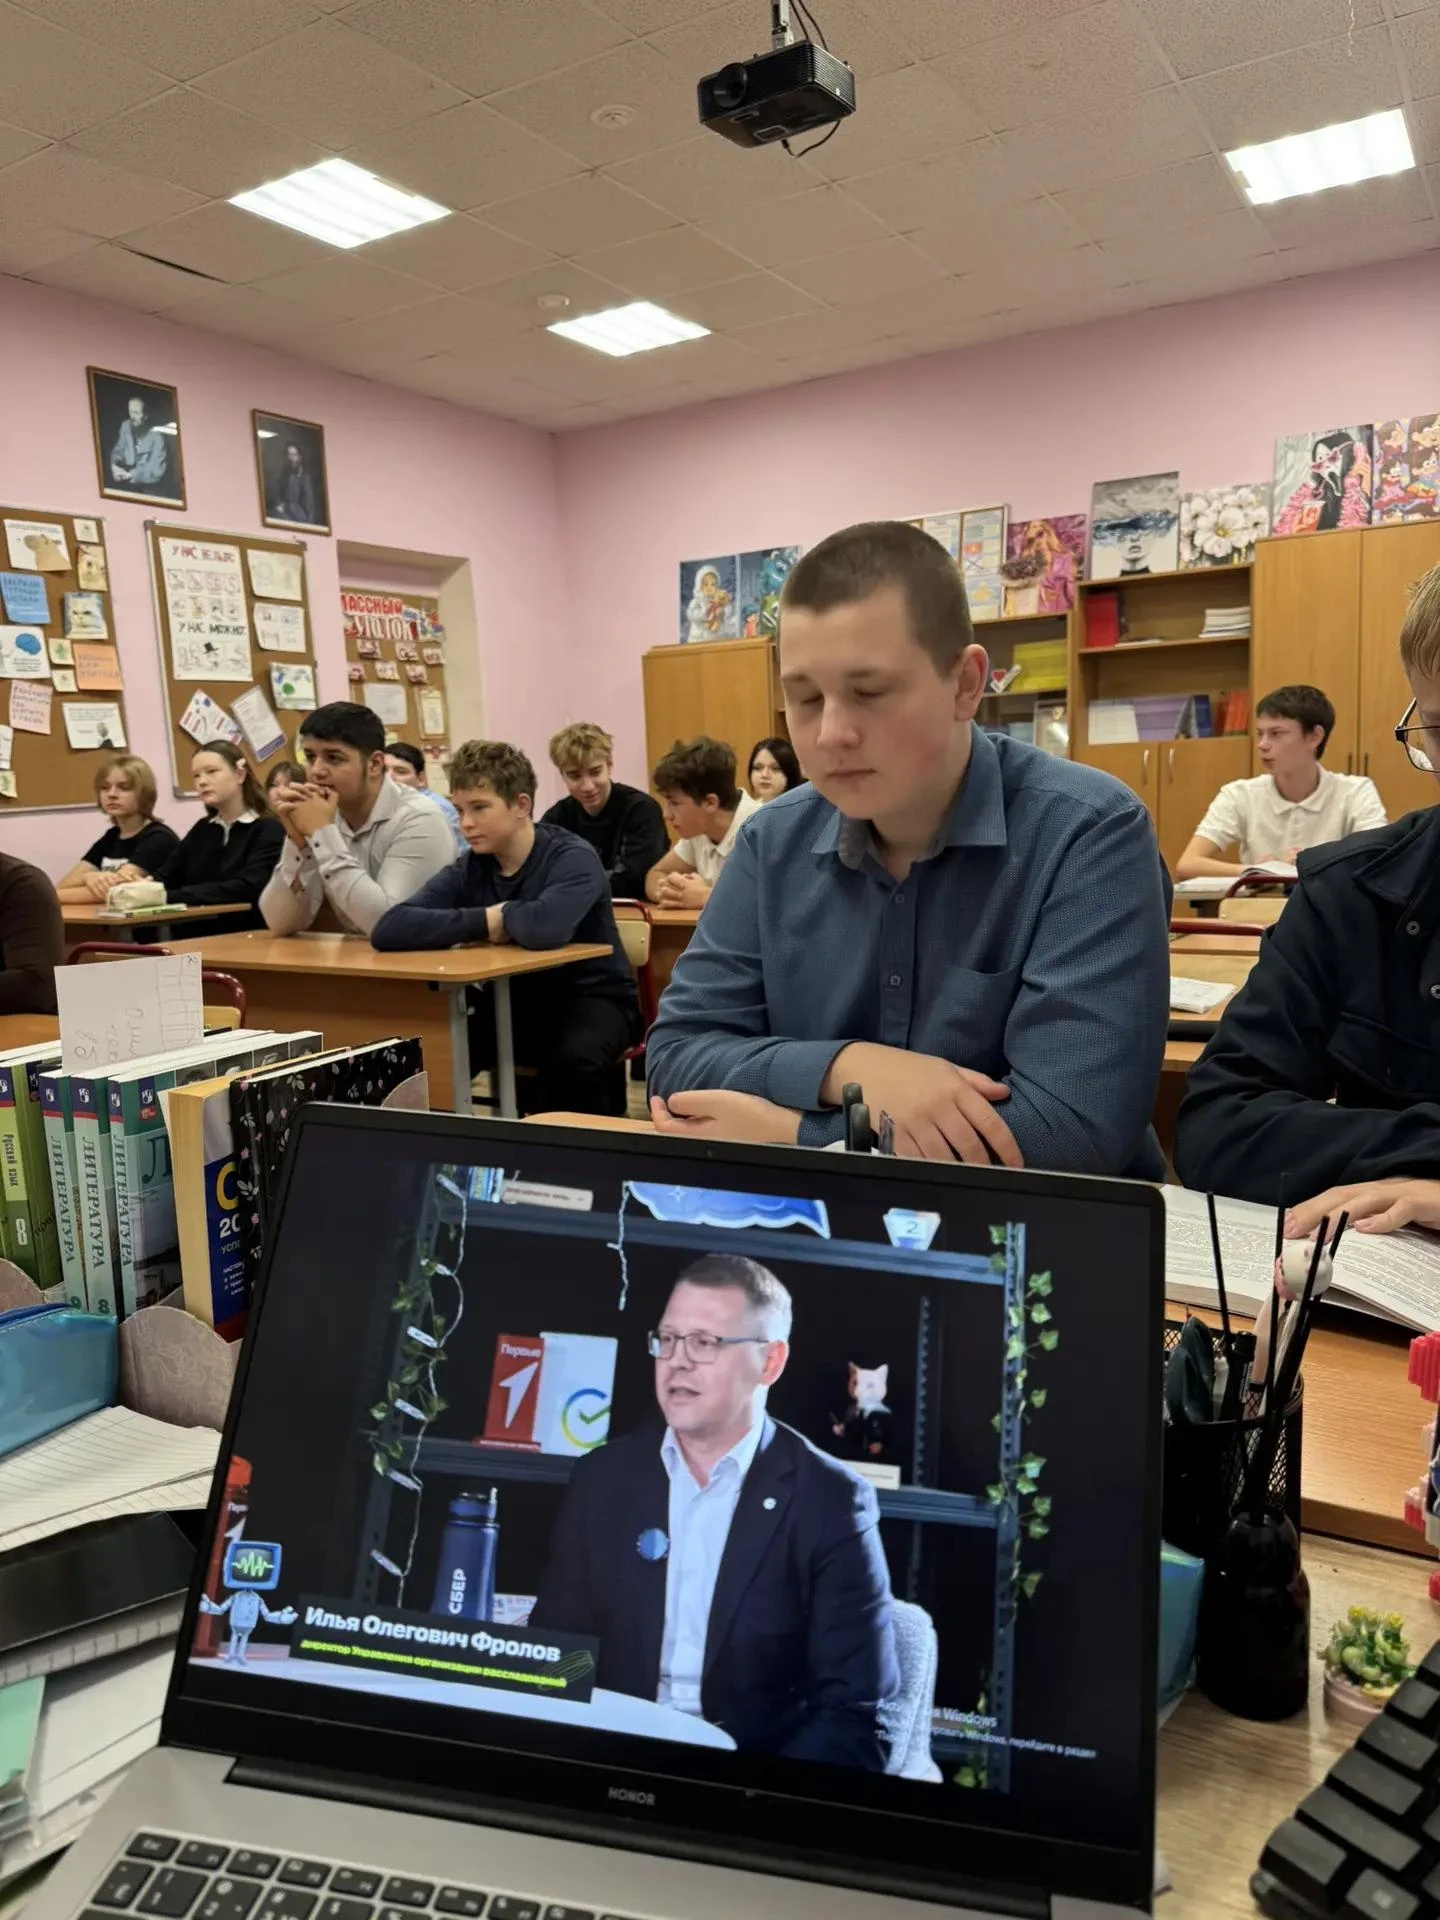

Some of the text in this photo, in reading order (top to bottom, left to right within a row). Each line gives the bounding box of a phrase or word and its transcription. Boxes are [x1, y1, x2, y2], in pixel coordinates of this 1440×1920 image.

[50, 1135, 75, 1264] ЛИТЕРАТУРА
[82, 1136, 105, 1269] ЛИТЕРАТУРА
[113, 1134, 133, 1267] ЛИТЕРАТУРА
[15, 1218, 28, 1246] 8
[448, 1568, 467, 1614] СБЕР
[304, 1606, 561, 1662] Илья Олегович Фролов
[942, 1707, 997, 1728] Windows
[608, 1786, 656, 1806] HONOR
